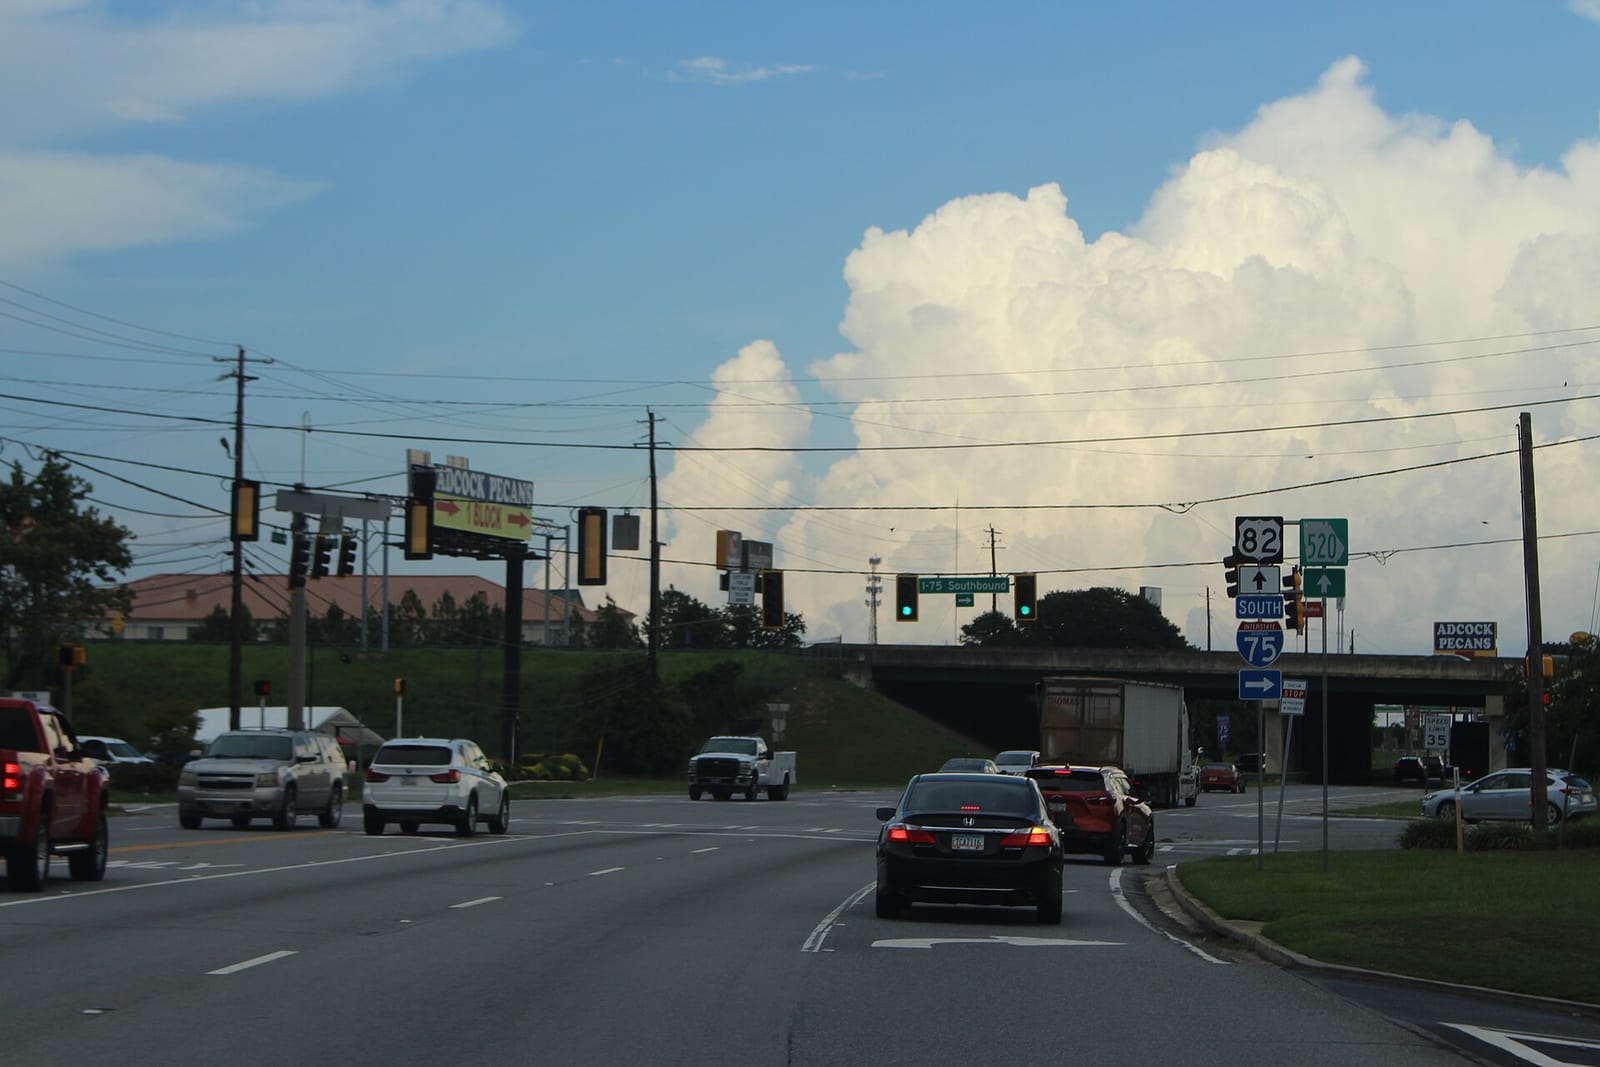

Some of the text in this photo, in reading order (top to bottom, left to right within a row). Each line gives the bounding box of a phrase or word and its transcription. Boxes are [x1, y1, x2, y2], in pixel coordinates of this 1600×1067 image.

[435, 467, 533, 506] ADCOCK PECANS
[473, 502, 502, 529] BLOCK
[1241, 527, 1277, 554] 82
[1307, 533, 1337, 559] 520
[921, 580, 1007, 591] I-75 Southbound
[1238, 599, 1281, 615] SOUTH
[1243, 623, 1277, 631] INTERSTATE
[1436, 623, 1493, 636] ADCOCK
[1243, 636, 1277, 663] 75
[1438, 637, 1492, 650] PECANS
[1283, 689, 1305, 698] STOP
[1427, 734, 1447, 746] 35
